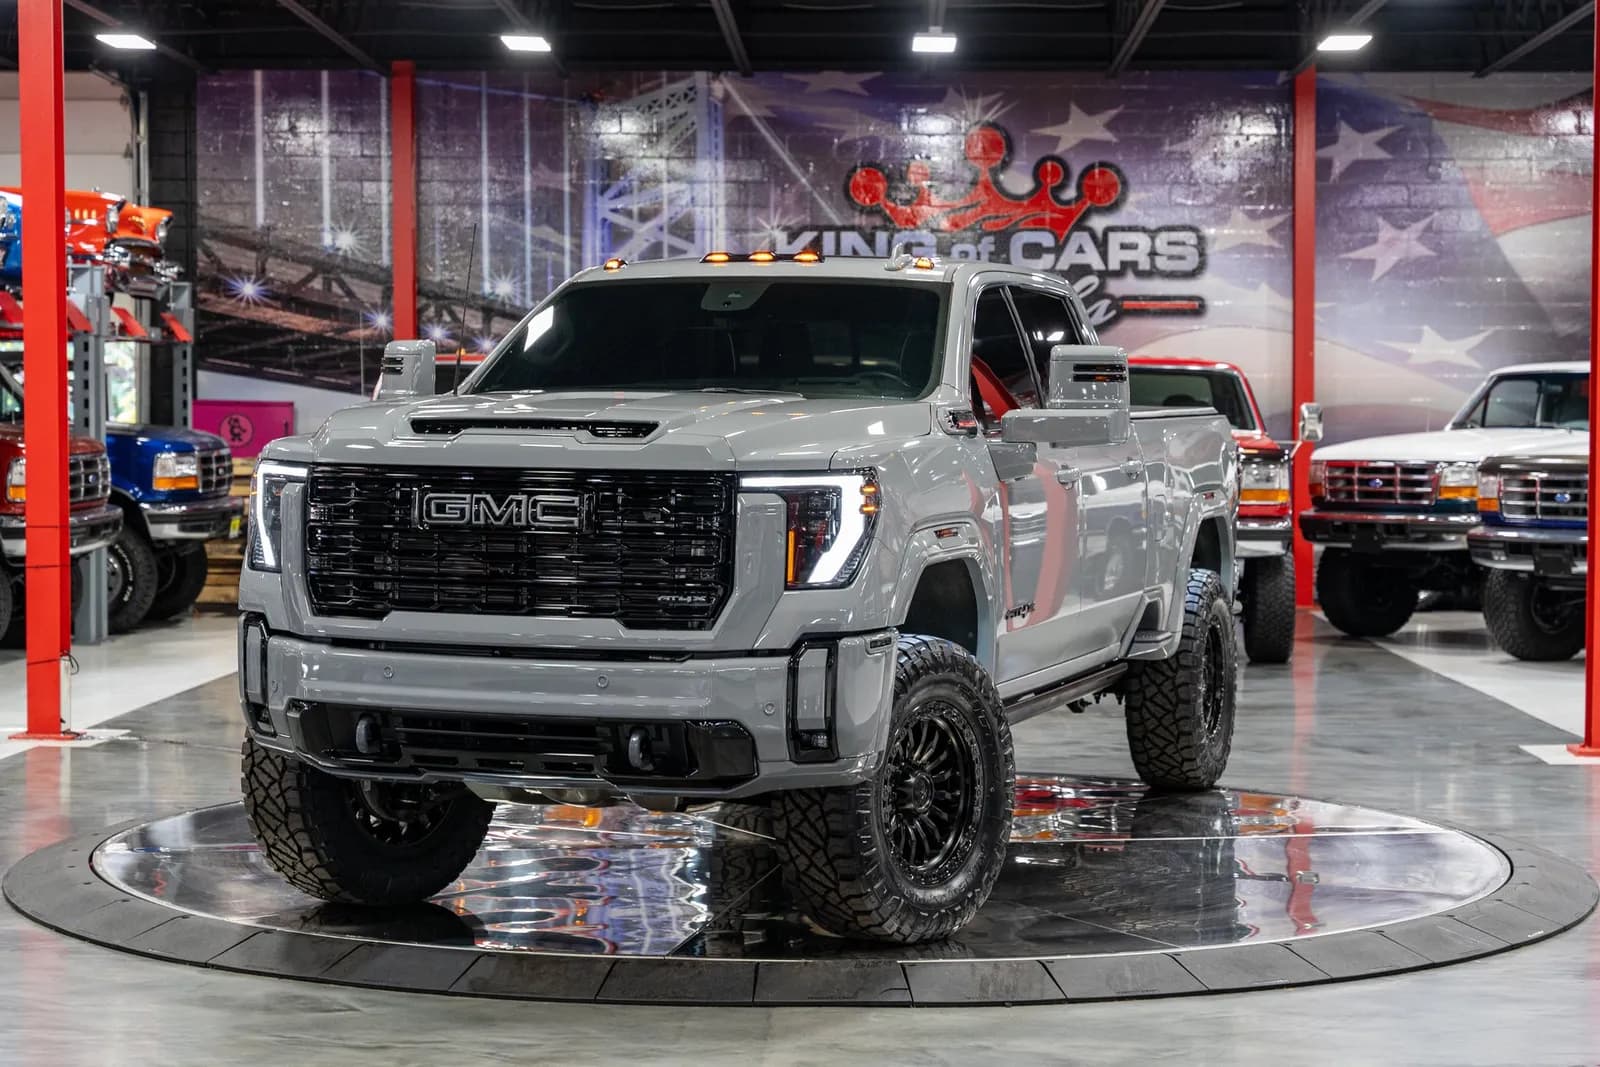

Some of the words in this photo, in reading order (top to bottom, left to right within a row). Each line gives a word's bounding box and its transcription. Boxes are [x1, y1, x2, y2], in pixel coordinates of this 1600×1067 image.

[950, 236, 995, 263] of
[1010, 231, 1200, 271] CARS
[423, 493, 580, 527] GMC
